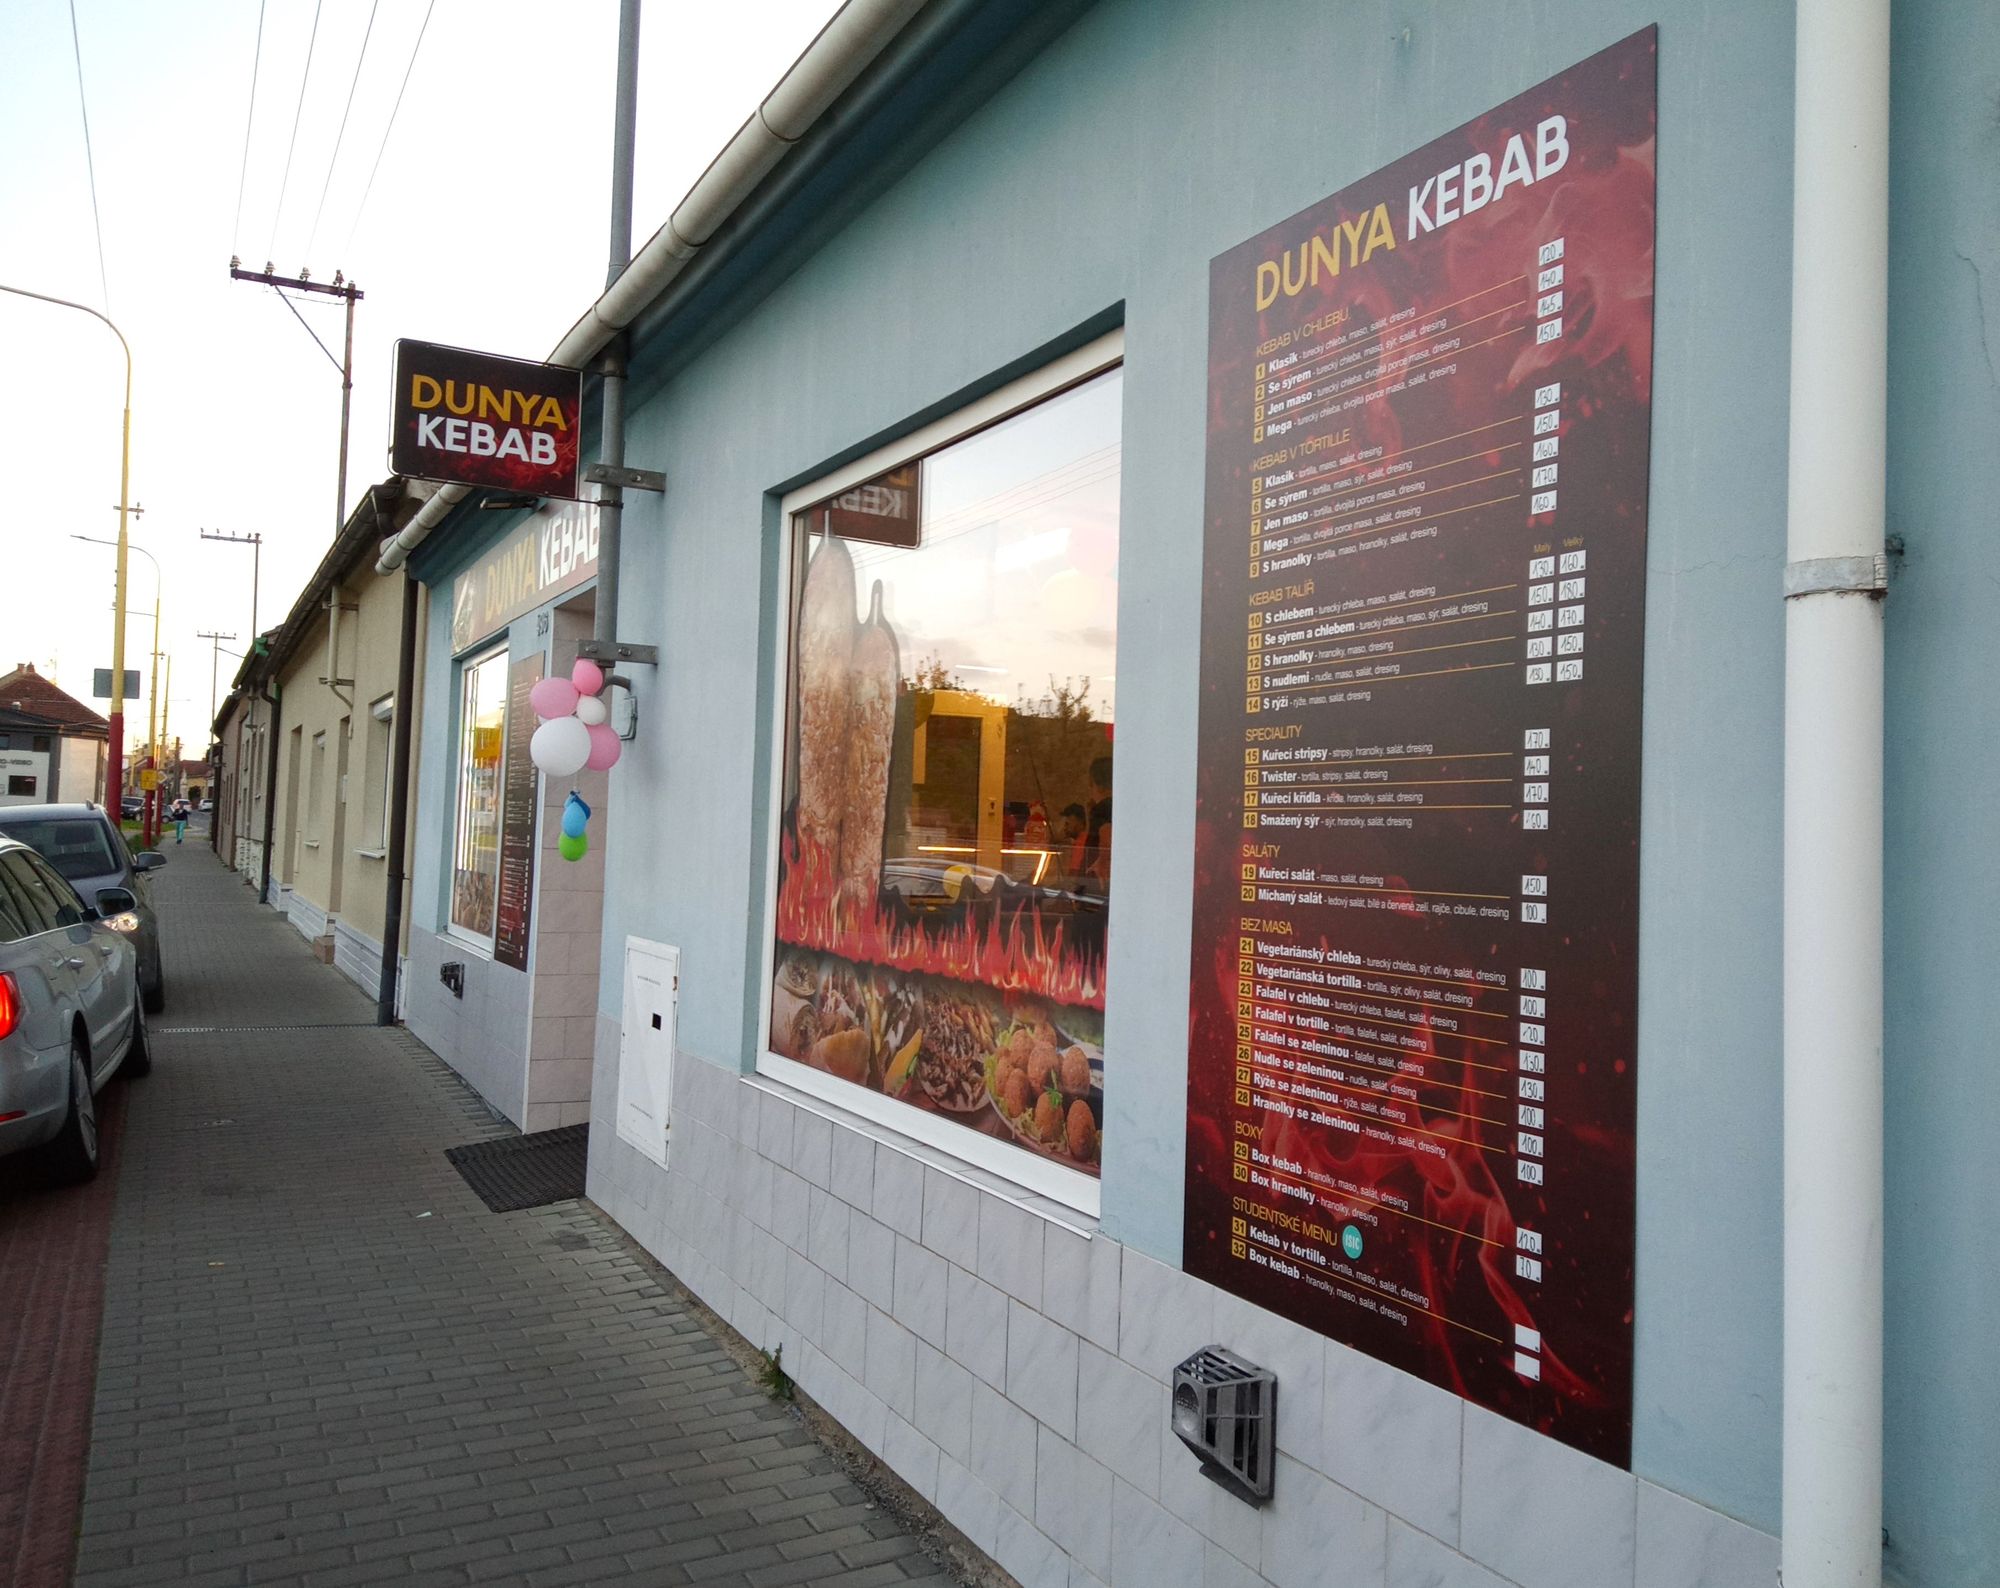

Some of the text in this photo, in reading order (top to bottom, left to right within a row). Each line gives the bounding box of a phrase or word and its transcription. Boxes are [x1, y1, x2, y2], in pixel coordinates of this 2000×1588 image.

[1255, 114, 1570, 312] DUNYA KEBAB
[1256, 331, 1290, 358] KEBAB
[1293, 327, 1300, 342] V
[1268, 351, 1298, 373] Klasik
[1268, 369, 1312, 394] Se sýrem
[411, 374, 568, 431] DUNYA
[1267, 391, 1313, 415] Jen maso
[417, 413, 558, 465] KEBAB
[1266, 420, 1293, 437] Mega
[1253, 428, 1350, 471] KEBAB V TORTILLE
[1265, 469, 1295, 488] Klasik
[1264, 489, 1308, 510] Se sýrem
[1263, 510, 1309, 531] Jen maso
[1263, 537, 1289, 552] Mega
[1270, 552, 1313, 572] hranolky
[1248, 588, 1283, 607] KEBAB
[1273, 607, 1314, 623] chlebem
[1264, 633, 1277, 646] Se
[1277, 630, 1305, 646] sýrem
[1314, 622, 1355, 638] chlebem
[1272, 649, 1314, 666] hranolky
[1272, 670, 1310, 687] nudlemi
[1271, 695, 1289, 711] rýží
[1245, 724, 1302, 742] SPECIALITY
[1262, 747, 1293, 761] Kuřecí
[1294, 746, 1328, 762] stripsy
[1261, 770, 1298, 783] Twister
[1261, 791, 1292, 805] Kuřecí
[1293, 791, 1321, 804] křídla
[1260, 813, 1321, 829] Smažený sýr
[1242, 843, 1280, 857] SALÁTY
[1258, 866, 1289, 880] Kuřecí
[1290, 868, 1316, 881] salát
[1258, 888, 1297, 905] Míchaný
[1298, 891, 1323, 905] salát
[1240, 917, 1292, 935] BEZ MASA
[1256, 940, 1325, 964] Vegetariánský
[1326, 949, 1362, 965] chleba
[1256, 962, 1325, 984] Vegetariánská
[1326, 972, 1362, 989] tortilla
[1255, 984, 1287, 1001] Falafel
[1296, 991, 1330, 1008] chlebu
[1255, 1006, 1287, 1023] Falafel
[1295, 1014, 1330, 1031] tortille
[1254, 1028, 1286, 1046] Falafel
[1287, 1037, 1300, 1049] se
[1301, 1039, 1350, 1059] zeleninou
[1254, 1050, 1345, 1081] Nudle se zeleninou
[1253, 1071, 1276, 1089] Rýže
[1277, 1080, 1290, 1092] se
[1290, 1083, 1339, 1104] zeleninou
[1252, 1093, 1360, 1134] Hranolky se zeleninou
[1235, 1120, 1263, 1141] BOXY
[1251, 1147, 1270, 1165] Box
[1272, 1154, 1303, 1175] kebab
[1251, 1170, 1270, 1188] Box
[1271, 1177, 1316, 1206] hranolky
[1232, 1193, 1359, 1251] STUDENTSKÉ MENU ISIC
[1249, 1225, 1281, 1248] Kebab
[1291, 1241, 1327, 1266] tortille
[1249, 1247, 1268, 1266] Box
[1269, 1256, 1300, 1280] kebab
